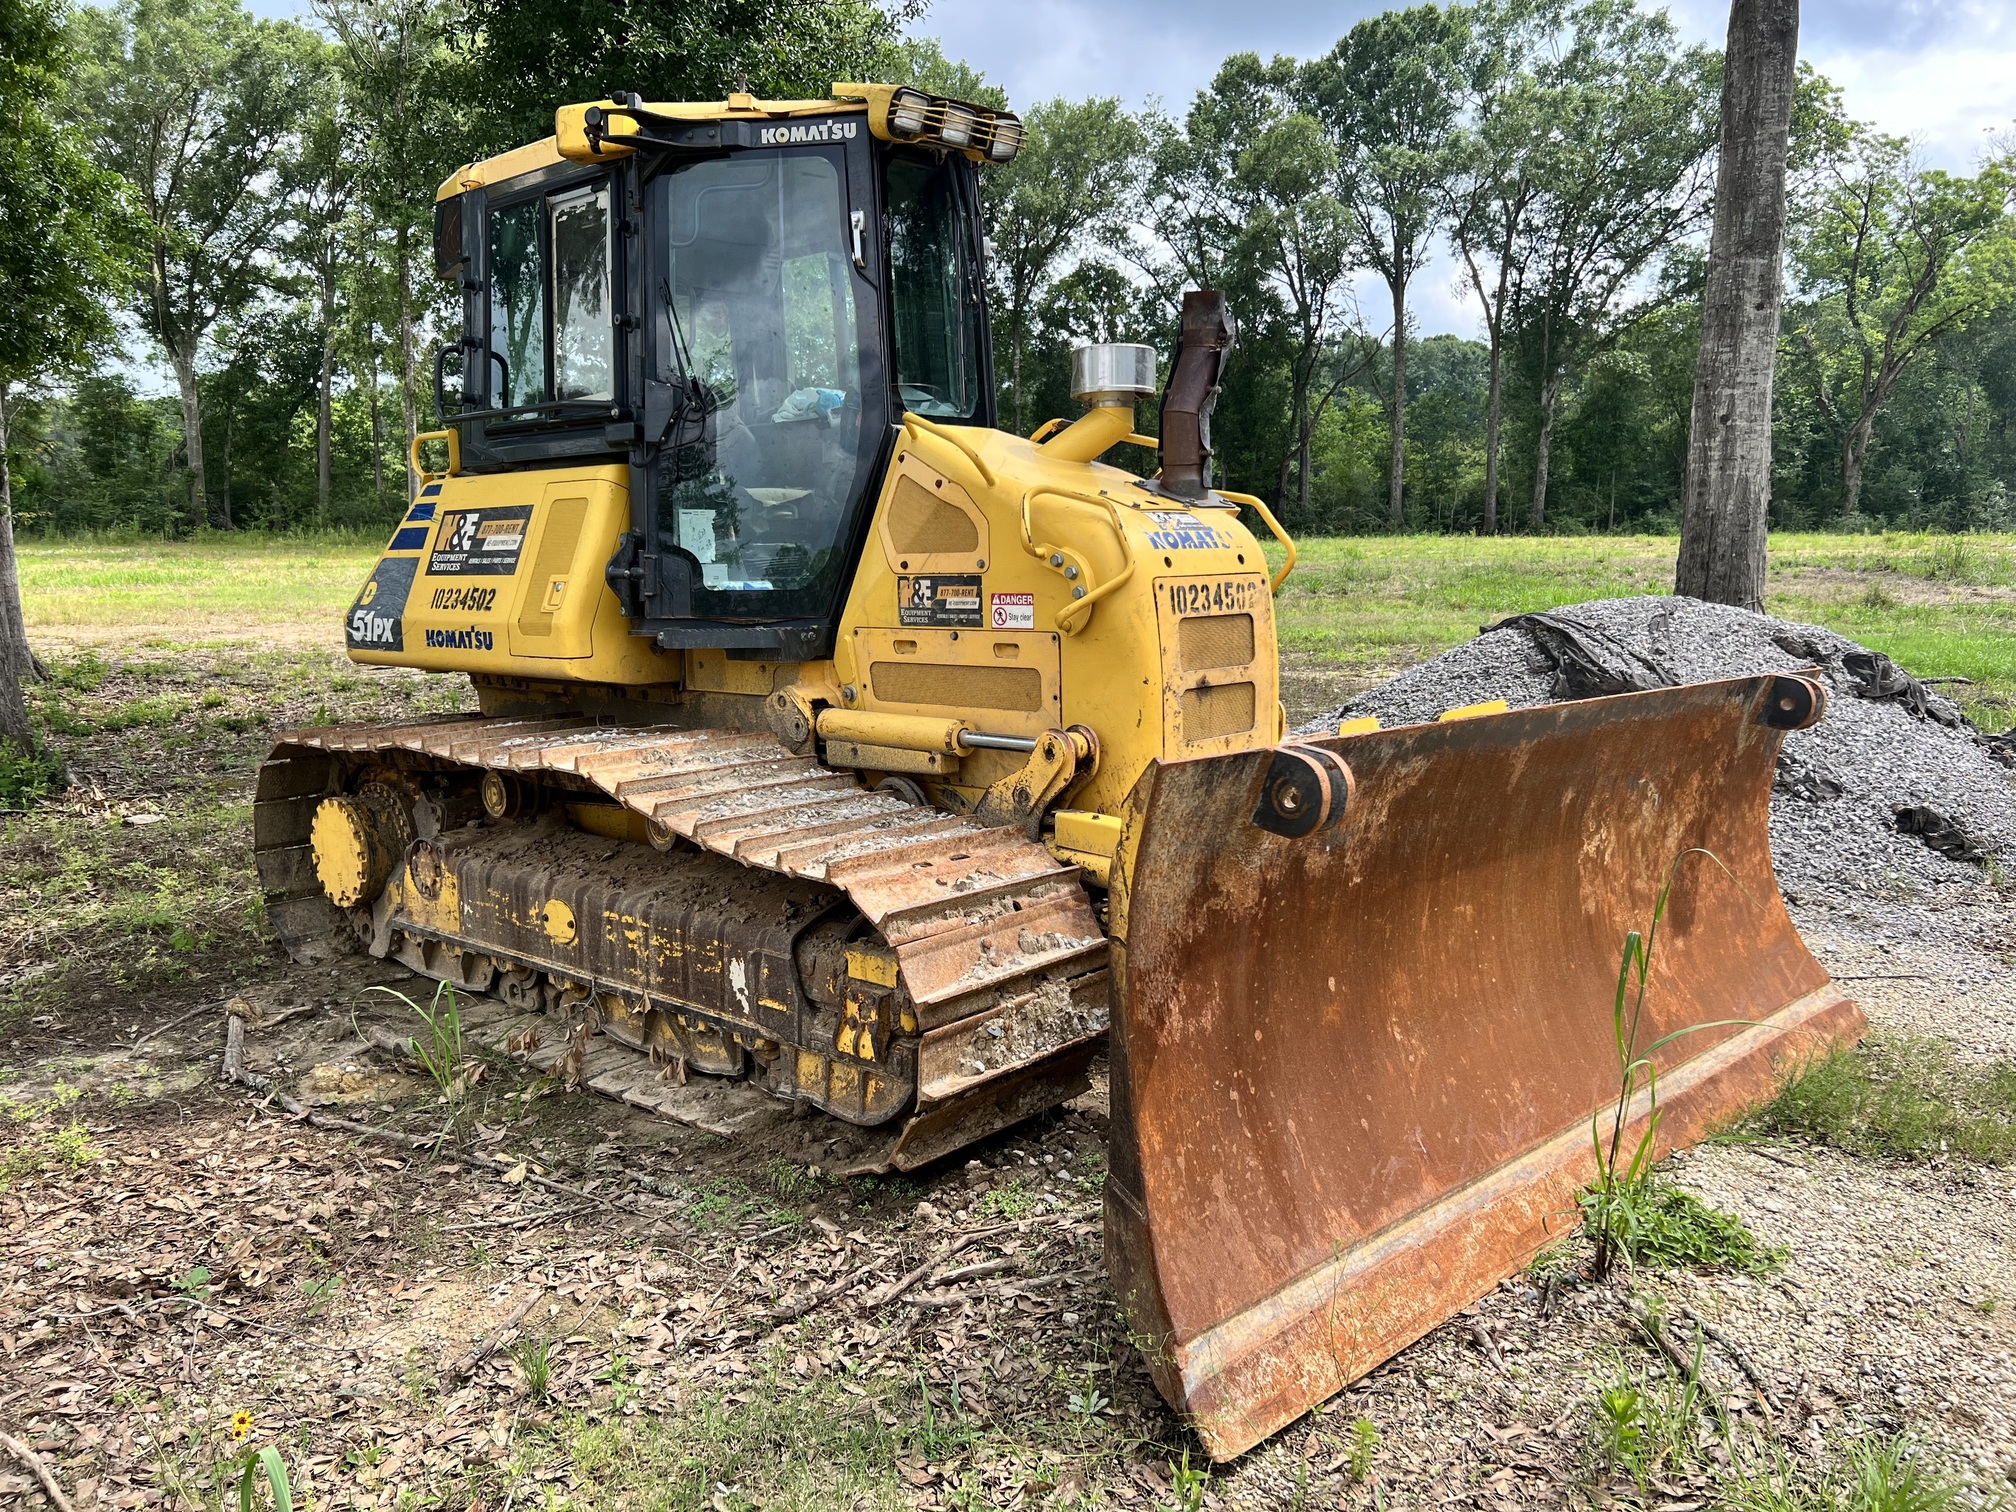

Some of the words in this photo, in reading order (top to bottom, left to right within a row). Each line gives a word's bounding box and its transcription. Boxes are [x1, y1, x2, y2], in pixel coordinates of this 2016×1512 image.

[761, 120, 857, 144] KOMATSU
[435, 513, 480, 551] H&E
[431, 552, 468, 562] EQUIPMENT
[431, 561, 461, 571] SERVICES
[360, 581, 378, 606] D
[430, 586, 496, 612] 10234502
[899, 579, 932, 609] H&E
[940, 588, 974, 597] 877-700-RENT
[1000, 595, 1033, 605] DANGER
[1169, 581, 1257, 615] 10234502
[900, 609, 932, 617] EQUIPMENT
[903, 615, 929, 624] SERVICES
[1008, 612, 1018, 622] Stay
[1019, 612, 1032, 620] clear
[352, 610, 395, 643] 51PX
[425, 625, 494, 651] KOMATSU
